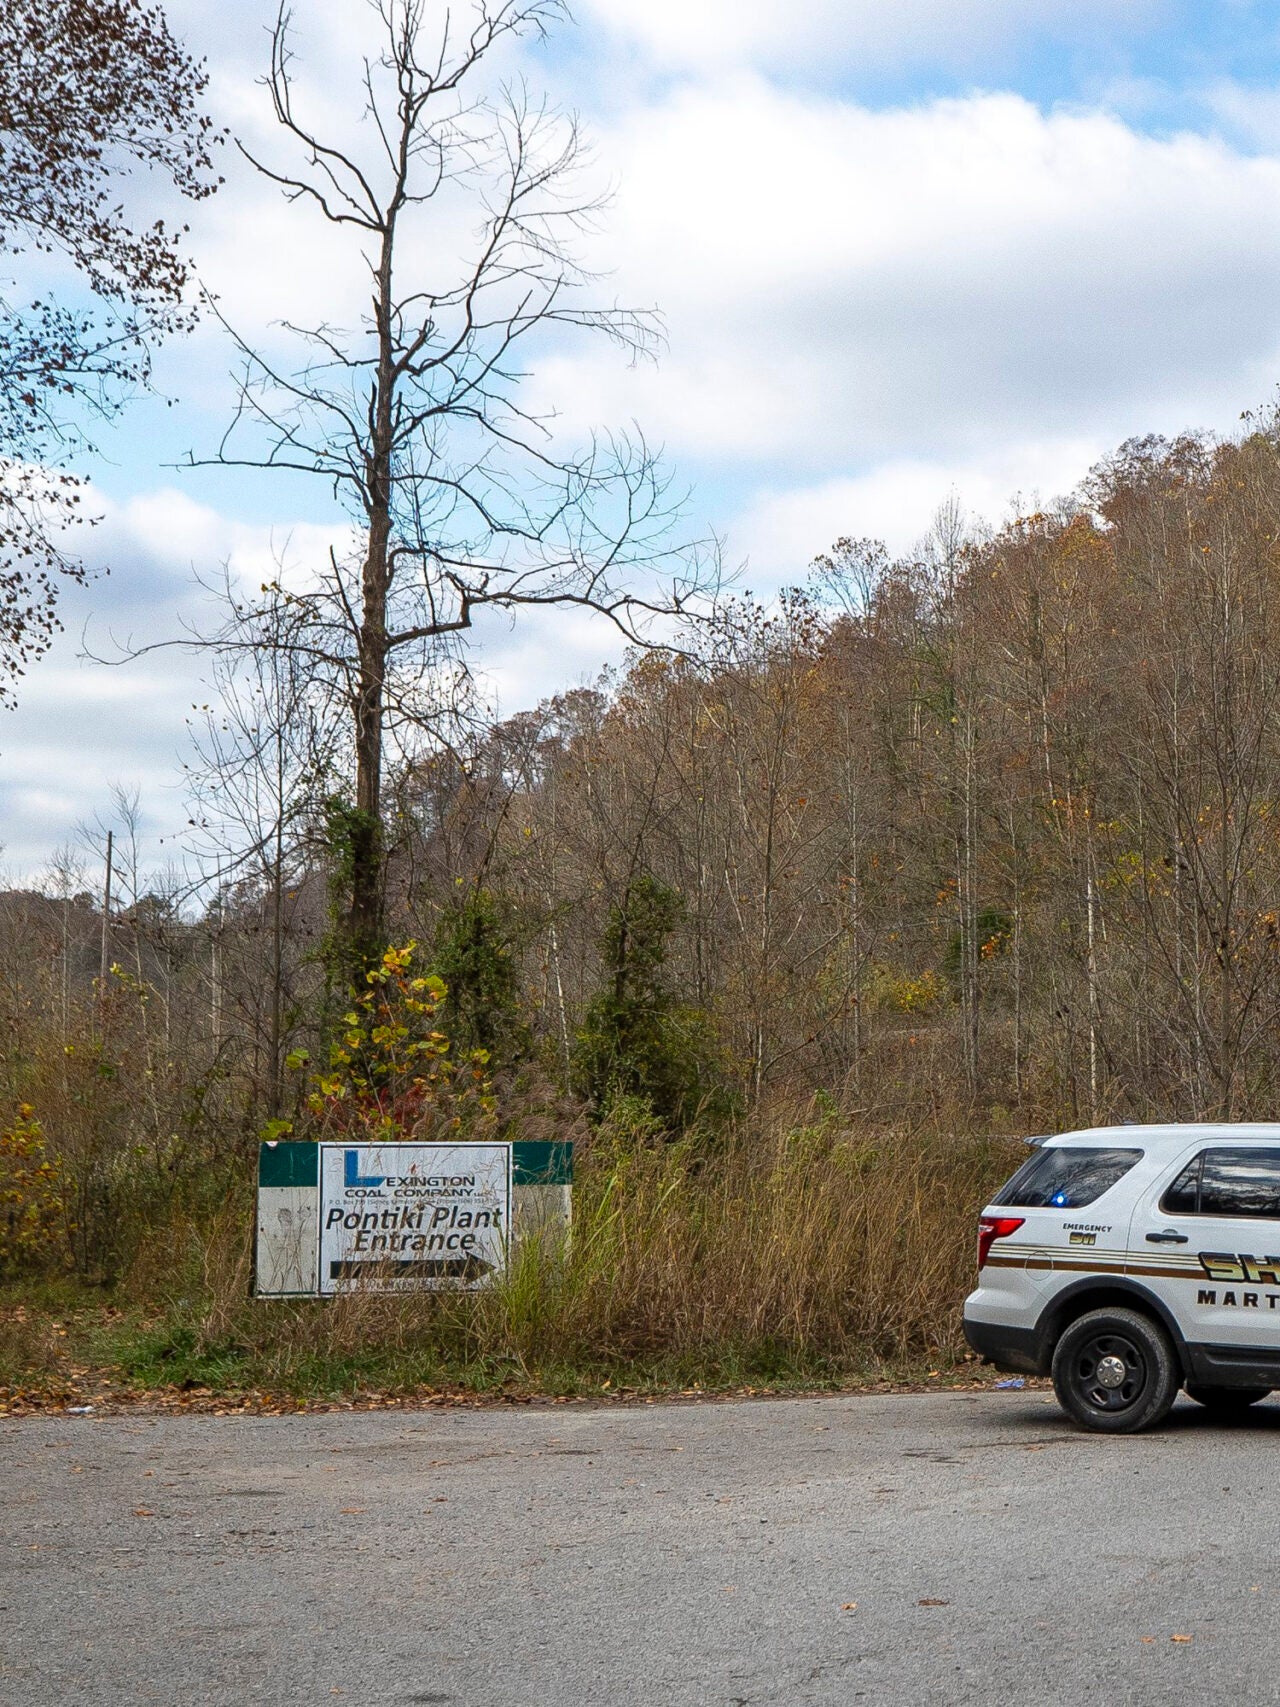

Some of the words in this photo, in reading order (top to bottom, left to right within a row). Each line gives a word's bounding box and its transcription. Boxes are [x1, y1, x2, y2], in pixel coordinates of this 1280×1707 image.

[344, 1150, 475, 1187] LEXINGTON
[344, 1188, 386, 1198] COAL
[394, 1188, 474, 1198] COMPANY
[325, 1206, 425, 1230] Pontiki
[431, 1205, 503, 1229] Plant
[1062, 1222, 1113, 1233] EMERGENCY
[353, 1229, 476, 1251] Entrance
